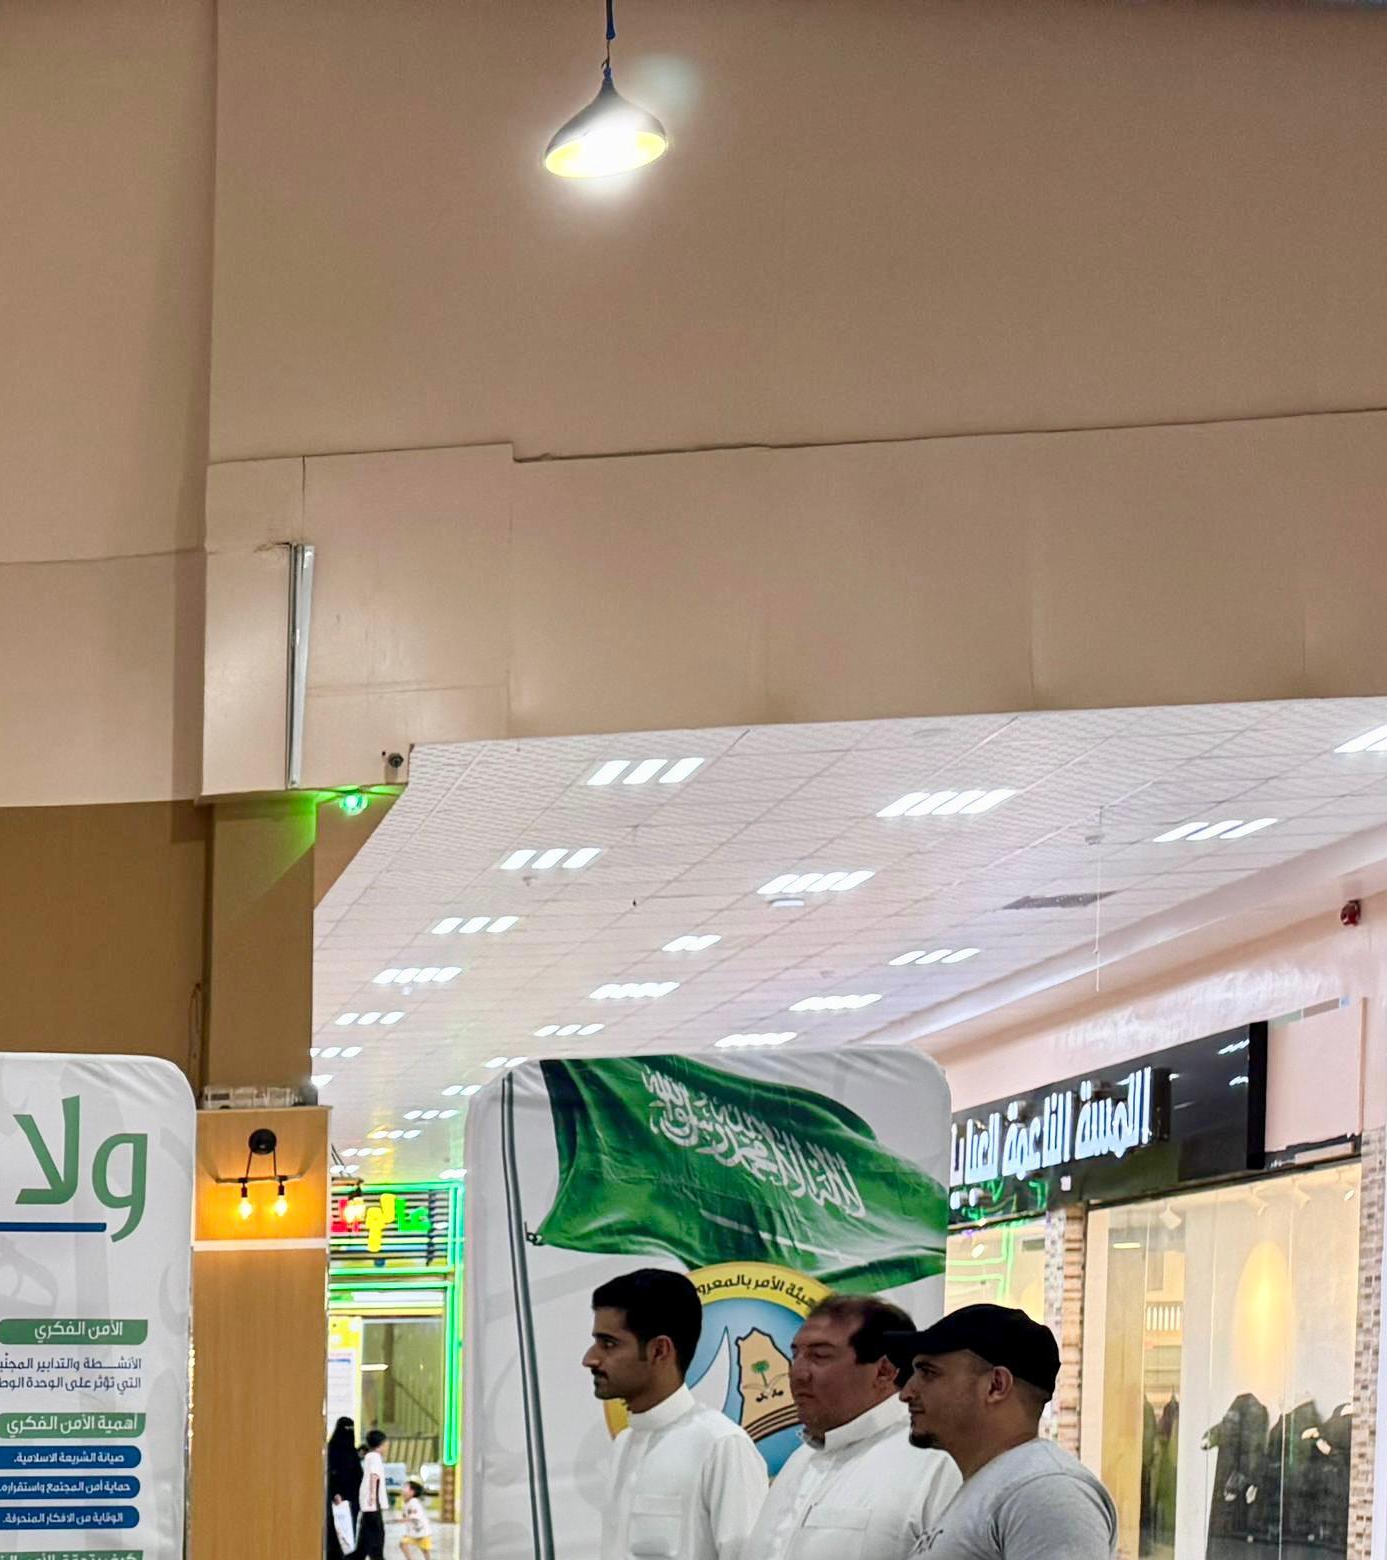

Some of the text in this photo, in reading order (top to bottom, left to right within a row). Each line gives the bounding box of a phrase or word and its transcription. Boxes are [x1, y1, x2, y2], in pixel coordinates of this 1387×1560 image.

[696, 1274, 752, 1296] بالمعرو
[753, 1275, 786, 1292] الأمر
[34, 1320, 124, 1345] الأمن الفكري
[37, 1358, 80, 1372] والتدابير
[26, 1377, 63, 1390] الوحدة
[65, 1377, 91, 1391] على
[94, 1375, 114, 1391] تؤثر
[117, 1377, 141, 1395] التي
[5, 1414, 139, 1436] أهمية الأمن الفكري
[59, 1451, 96, 1466] الشريعة
[97, 1451, 126, 1465] صيانة
